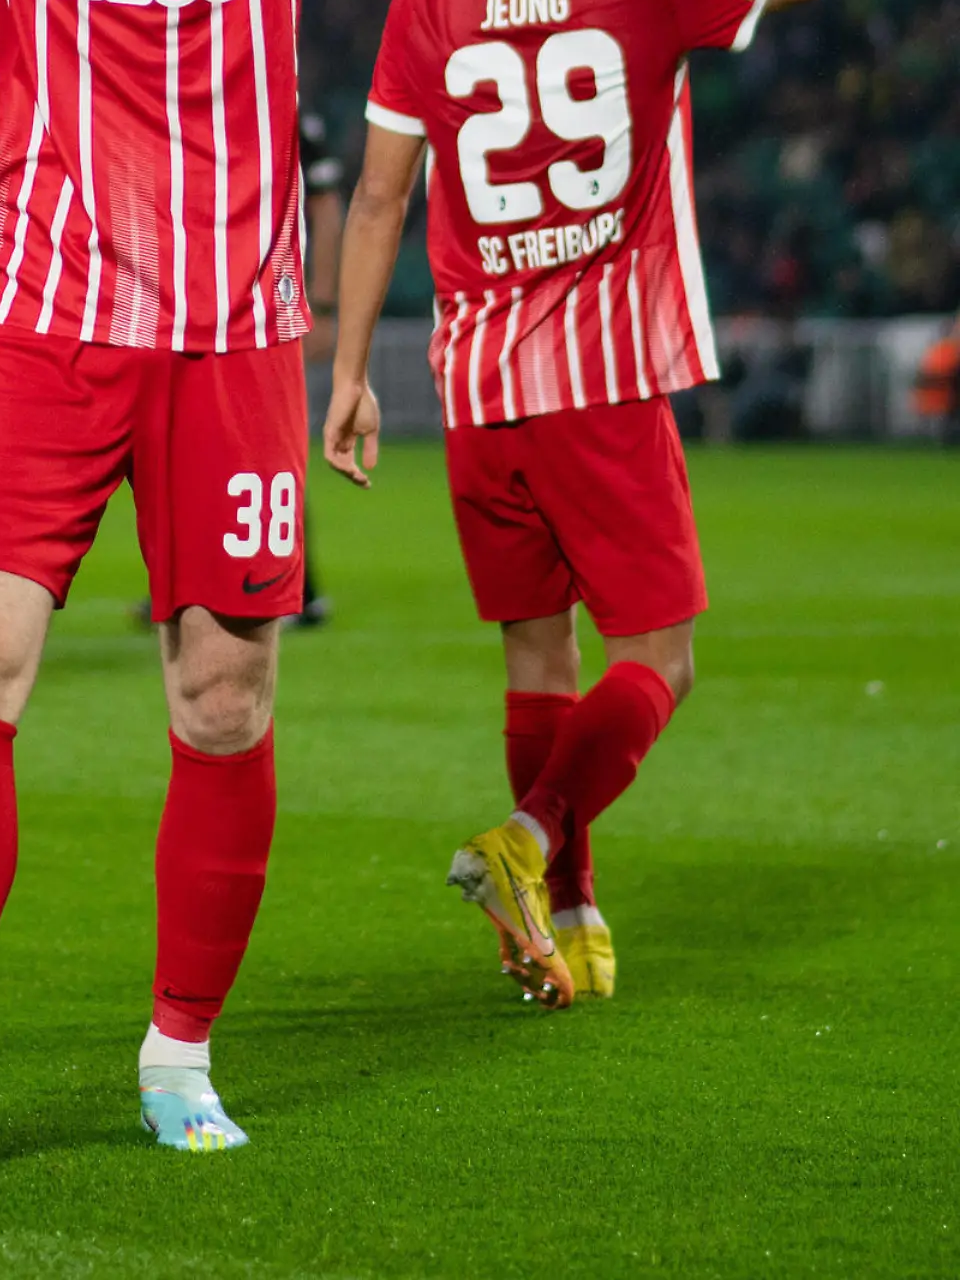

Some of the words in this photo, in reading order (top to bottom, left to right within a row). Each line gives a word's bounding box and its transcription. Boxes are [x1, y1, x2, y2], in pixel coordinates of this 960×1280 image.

[444, 28, 632, 225] 29
[477, 236, 509, 275] SC
[222, 471, 297, 558] 38
